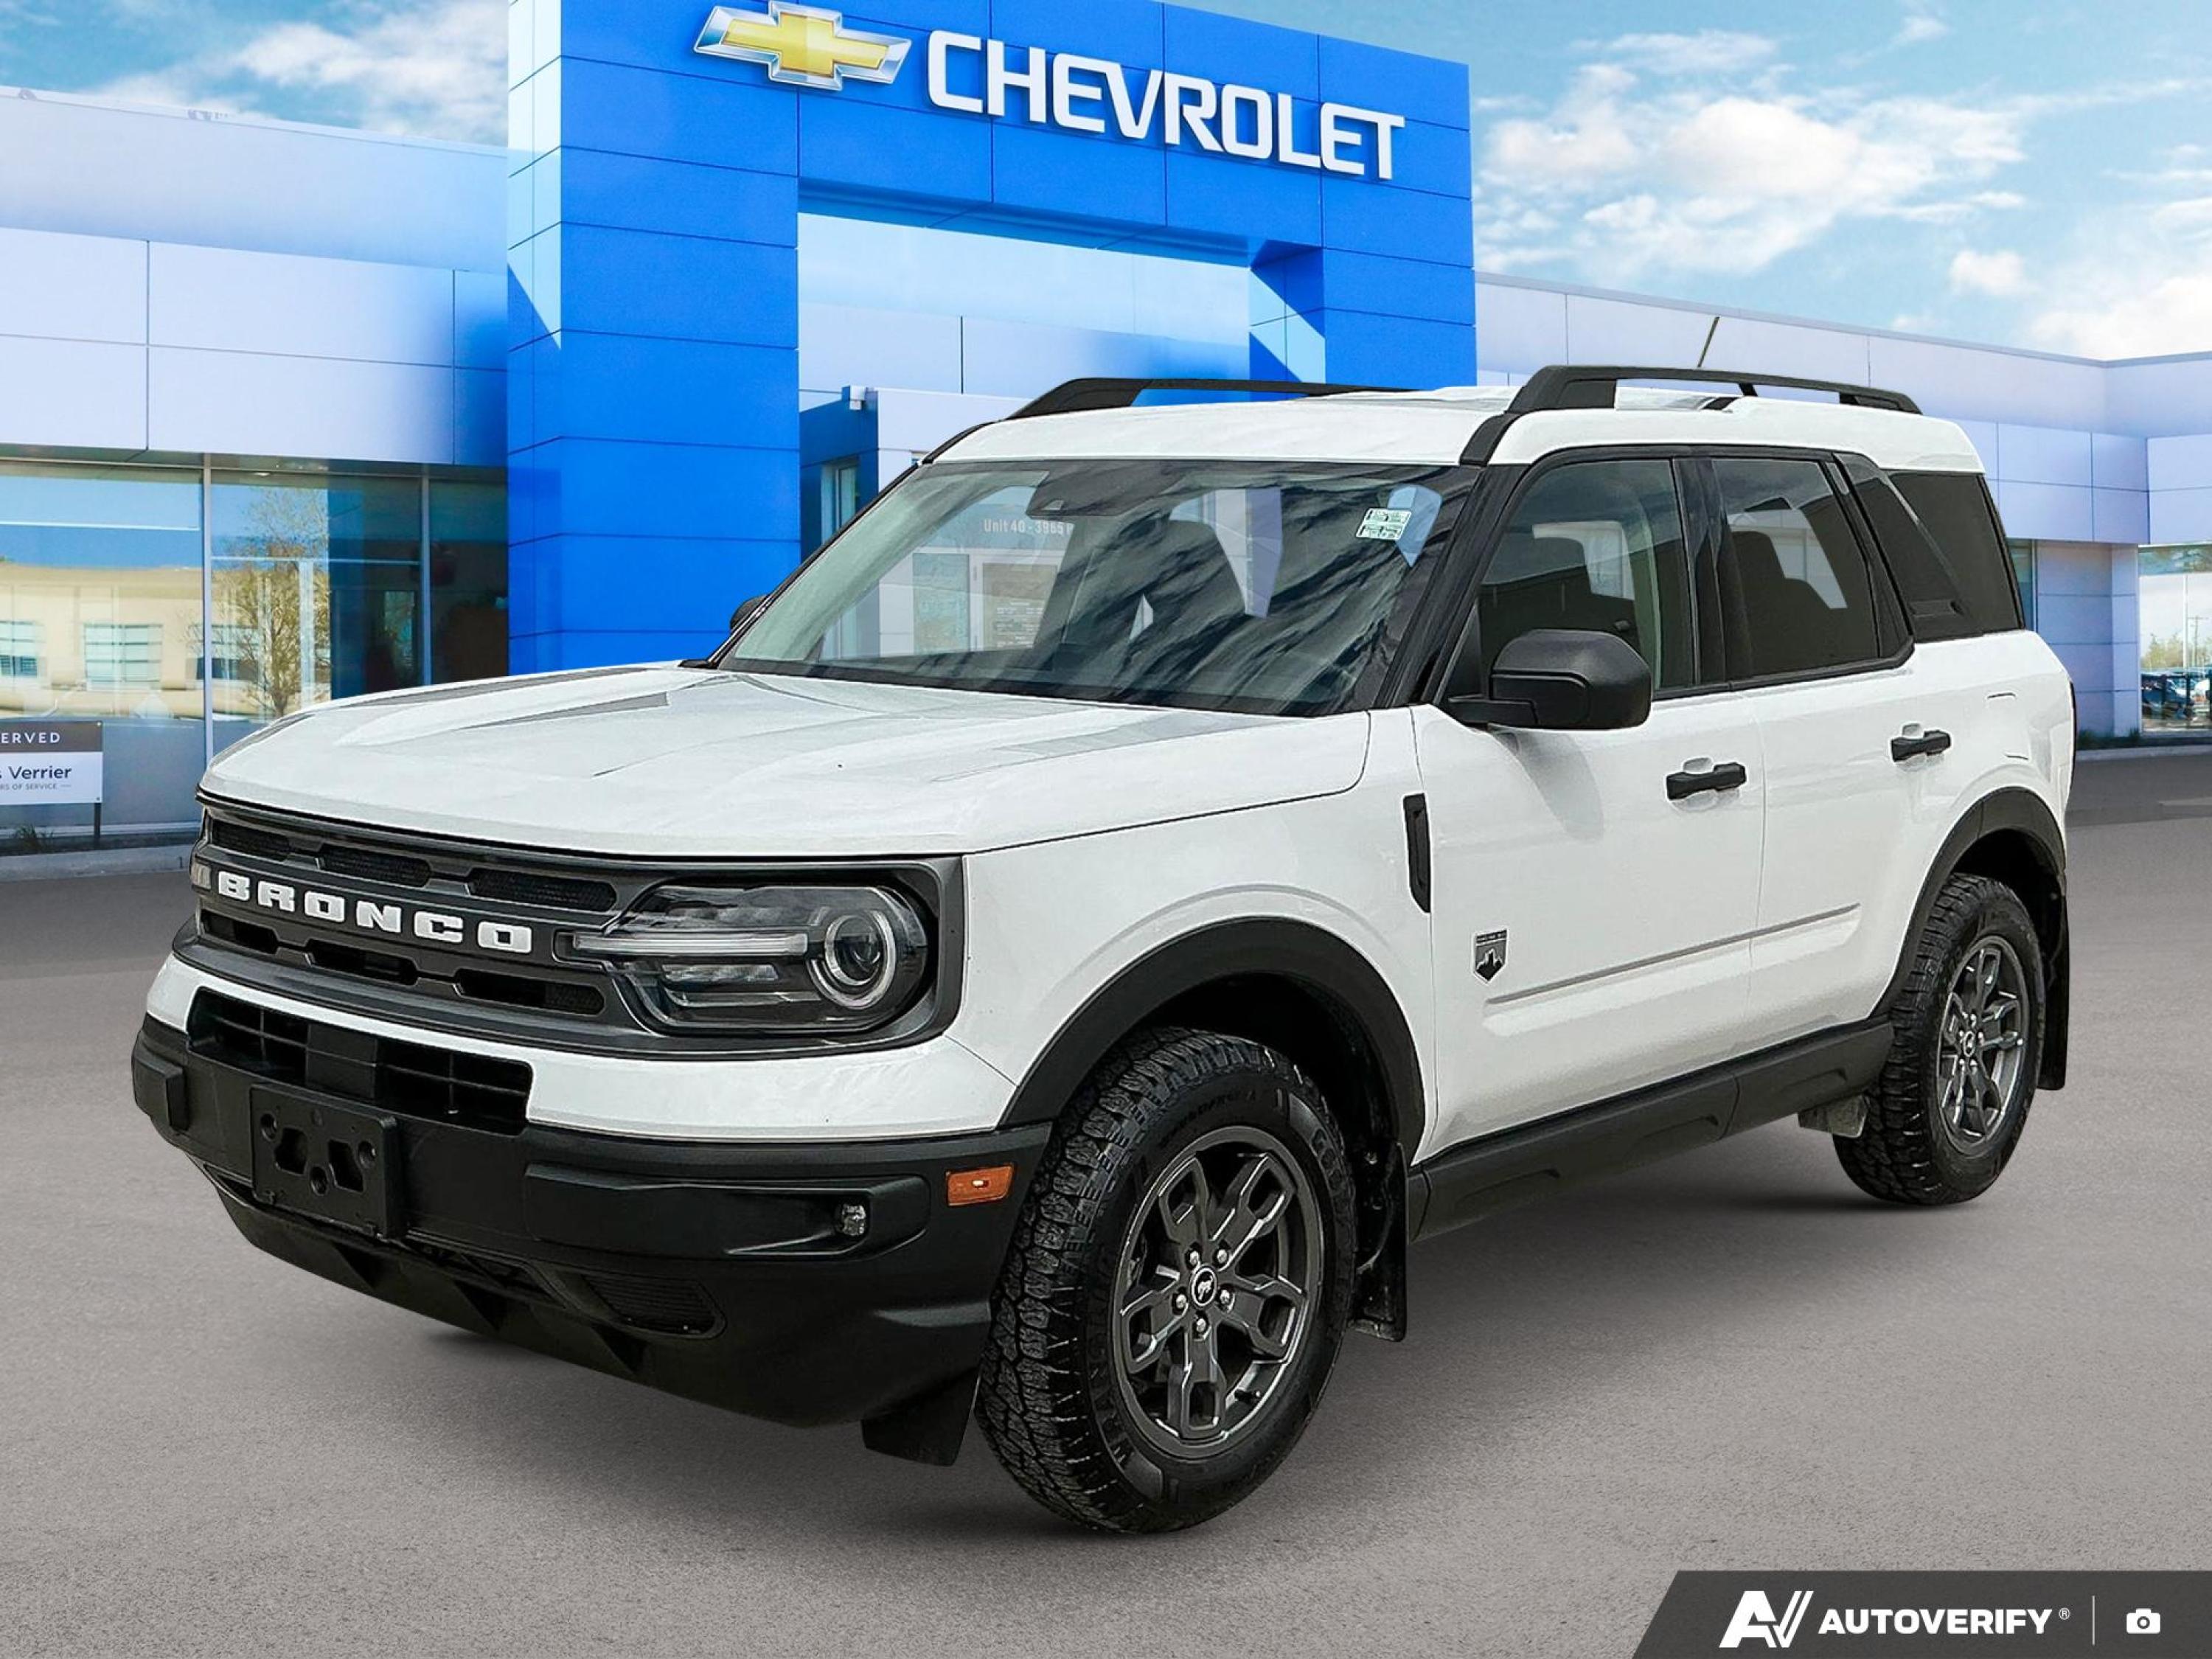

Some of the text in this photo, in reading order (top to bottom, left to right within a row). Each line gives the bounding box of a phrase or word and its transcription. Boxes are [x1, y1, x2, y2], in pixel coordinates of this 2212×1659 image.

[928, 29, 1405, 180] CHEVROLET
[984, 519, 1009, 532] Unit
[1010, 519, 1026, 532] 40
[8, 765, 72, 779] Verrier
[218, 870, 532, 954] BRONCO
